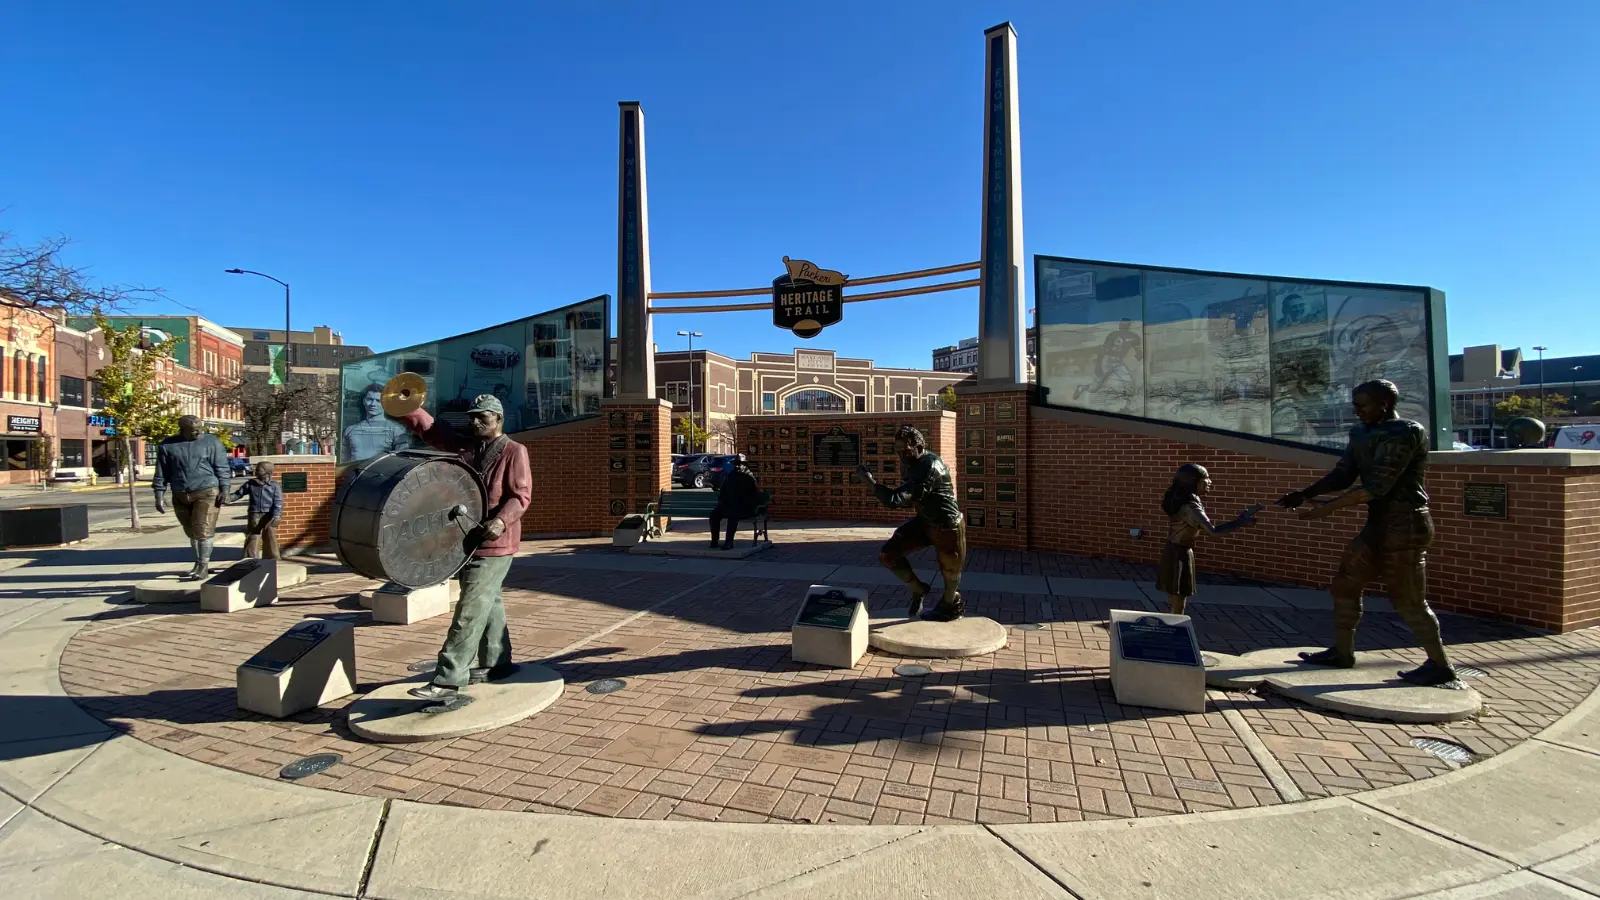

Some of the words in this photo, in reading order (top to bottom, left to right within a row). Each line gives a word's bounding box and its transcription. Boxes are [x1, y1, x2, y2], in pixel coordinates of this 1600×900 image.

[993, 69, 1002, 111] FROM
[993, 126, 1003, 202] LAMBEAU
[993, 216, 1003, 237] TO
[799, 263, 831, 282] Packers
[781, 290, 833, 306] HERITAGE
[785, 304, 829, 316] TRAIL
[11, 417, 39, 425] HEIGHTS
